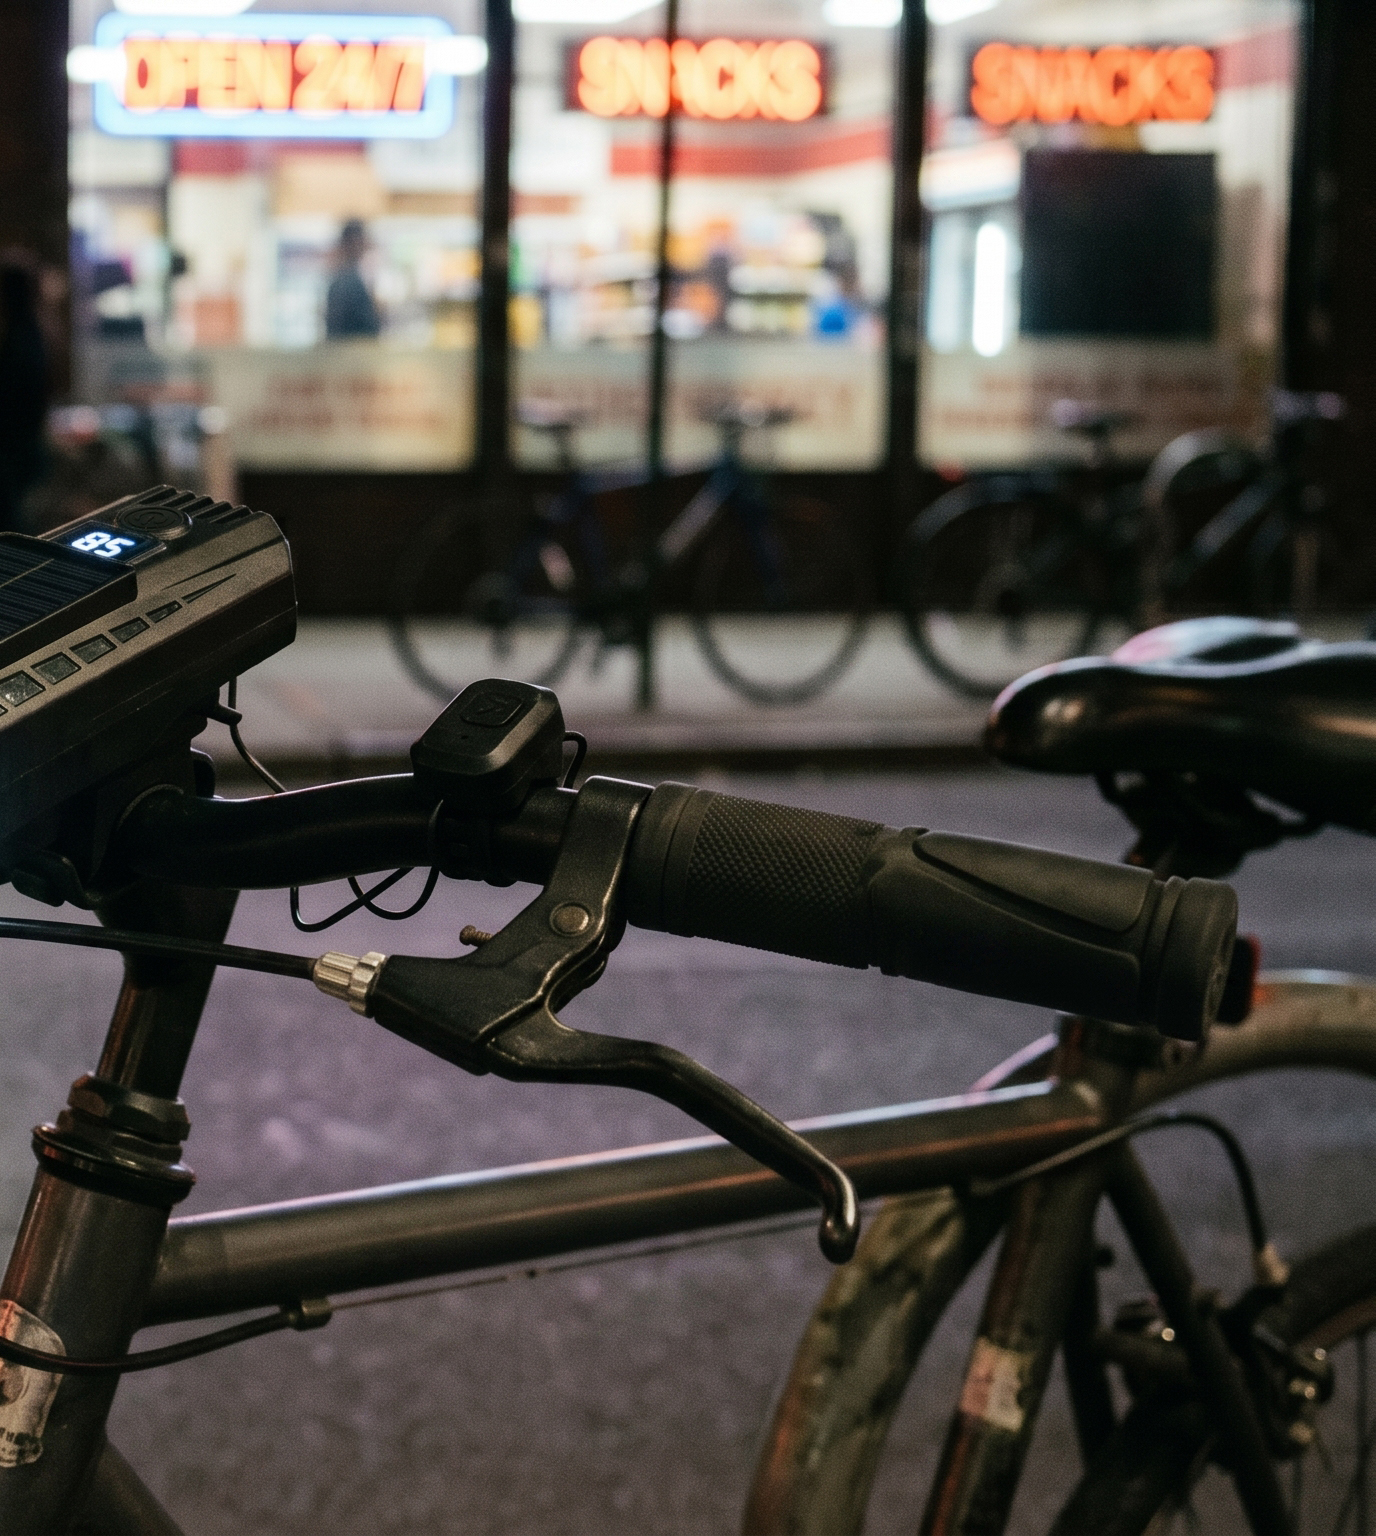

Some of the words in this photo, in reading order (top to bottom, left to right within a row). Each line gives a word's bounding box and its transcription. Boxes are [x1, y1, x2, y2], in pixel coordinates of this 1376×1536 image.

[121, 33, 292, 116] OPEN
[292, 33, 427, 117] 24/7
[577, 36, 822, 121] SNACKS
[970, 42, 1214, 126] SNACKS
[71, 531, 135, 558] 85
